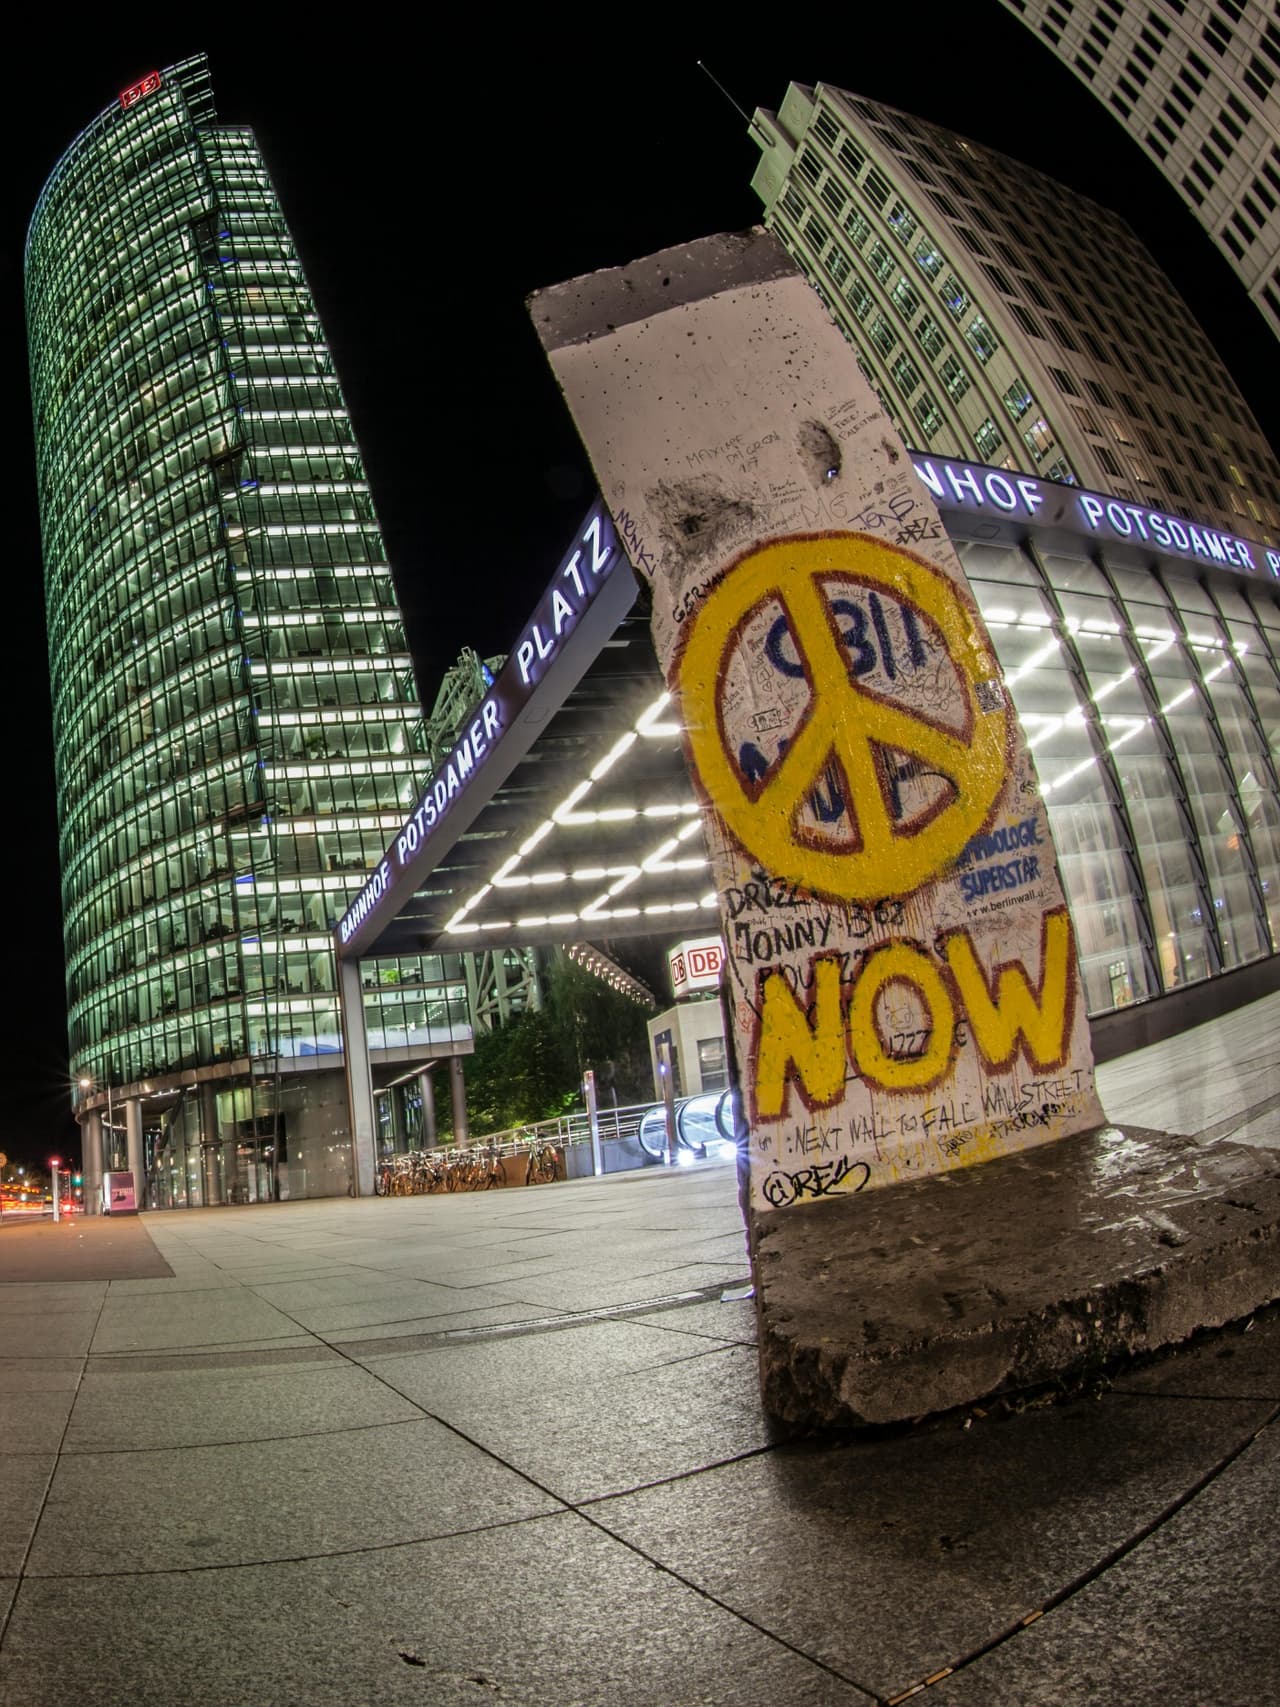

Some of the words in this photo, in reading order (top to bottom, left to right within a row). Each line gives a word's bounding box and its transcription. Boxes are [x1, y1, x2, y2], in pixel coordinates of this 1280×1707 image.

[1079, 494, 1256, 571] POTSDAMER
[340, 860, 389, 944] BAHNHOF
[397, 699, 505, 866] POTSDAMER
[517, 514, 614, 685] PLATZ
[960, 854, 1042, 904] SUPERSTAR
[692, 951, 720, 974] DB
[734, 911, 833, 965] JONNY
[672, 958, 685, 982] DB
[749, 906, 1077, 1129] NOW
[795, 1121, 843, 1155] NEXT
[849, 1114, 896, 1146] WALL
[921, 1100, 977, 1137] FALL
